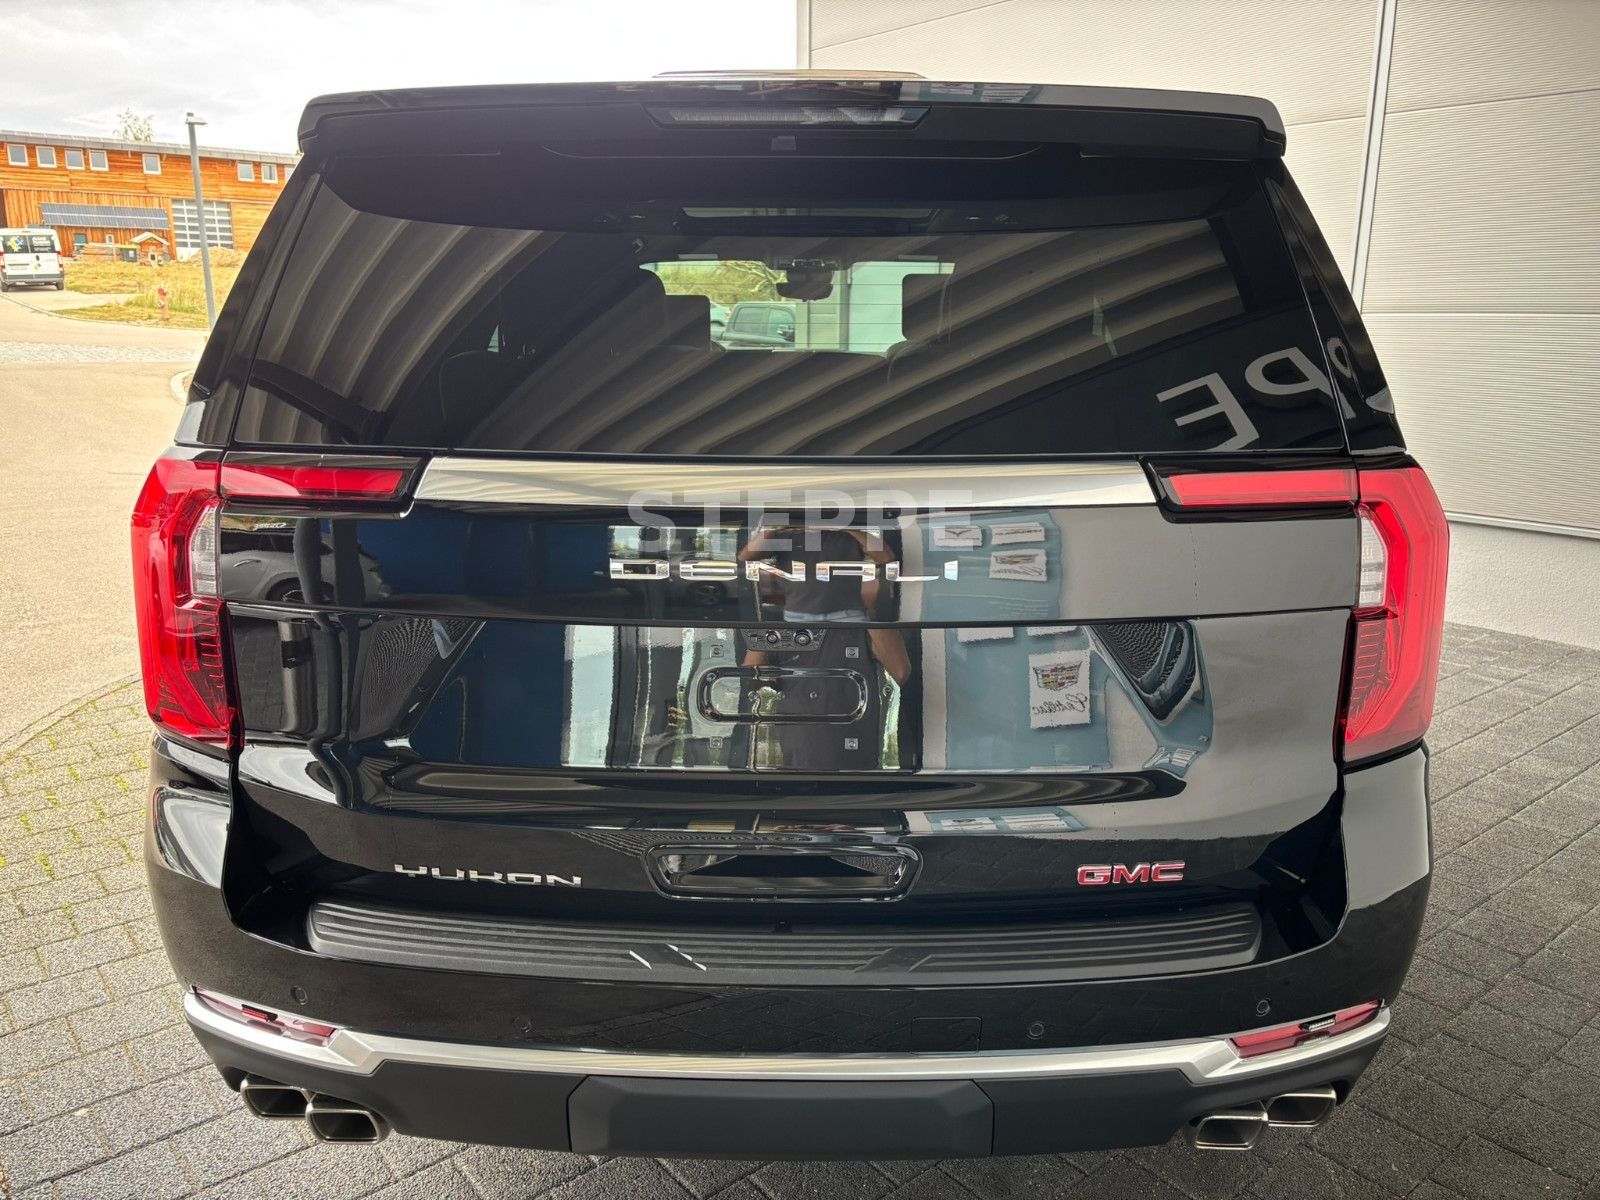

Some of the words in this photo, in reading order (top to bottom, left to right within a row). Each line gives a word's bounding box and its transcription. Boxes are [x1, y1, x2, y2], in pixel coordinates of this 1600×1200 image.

[609, 558, 958, 582] DENALI
[394, 864, 582, 887] YUKON
[1077, 860, 1186, 885] GMC
